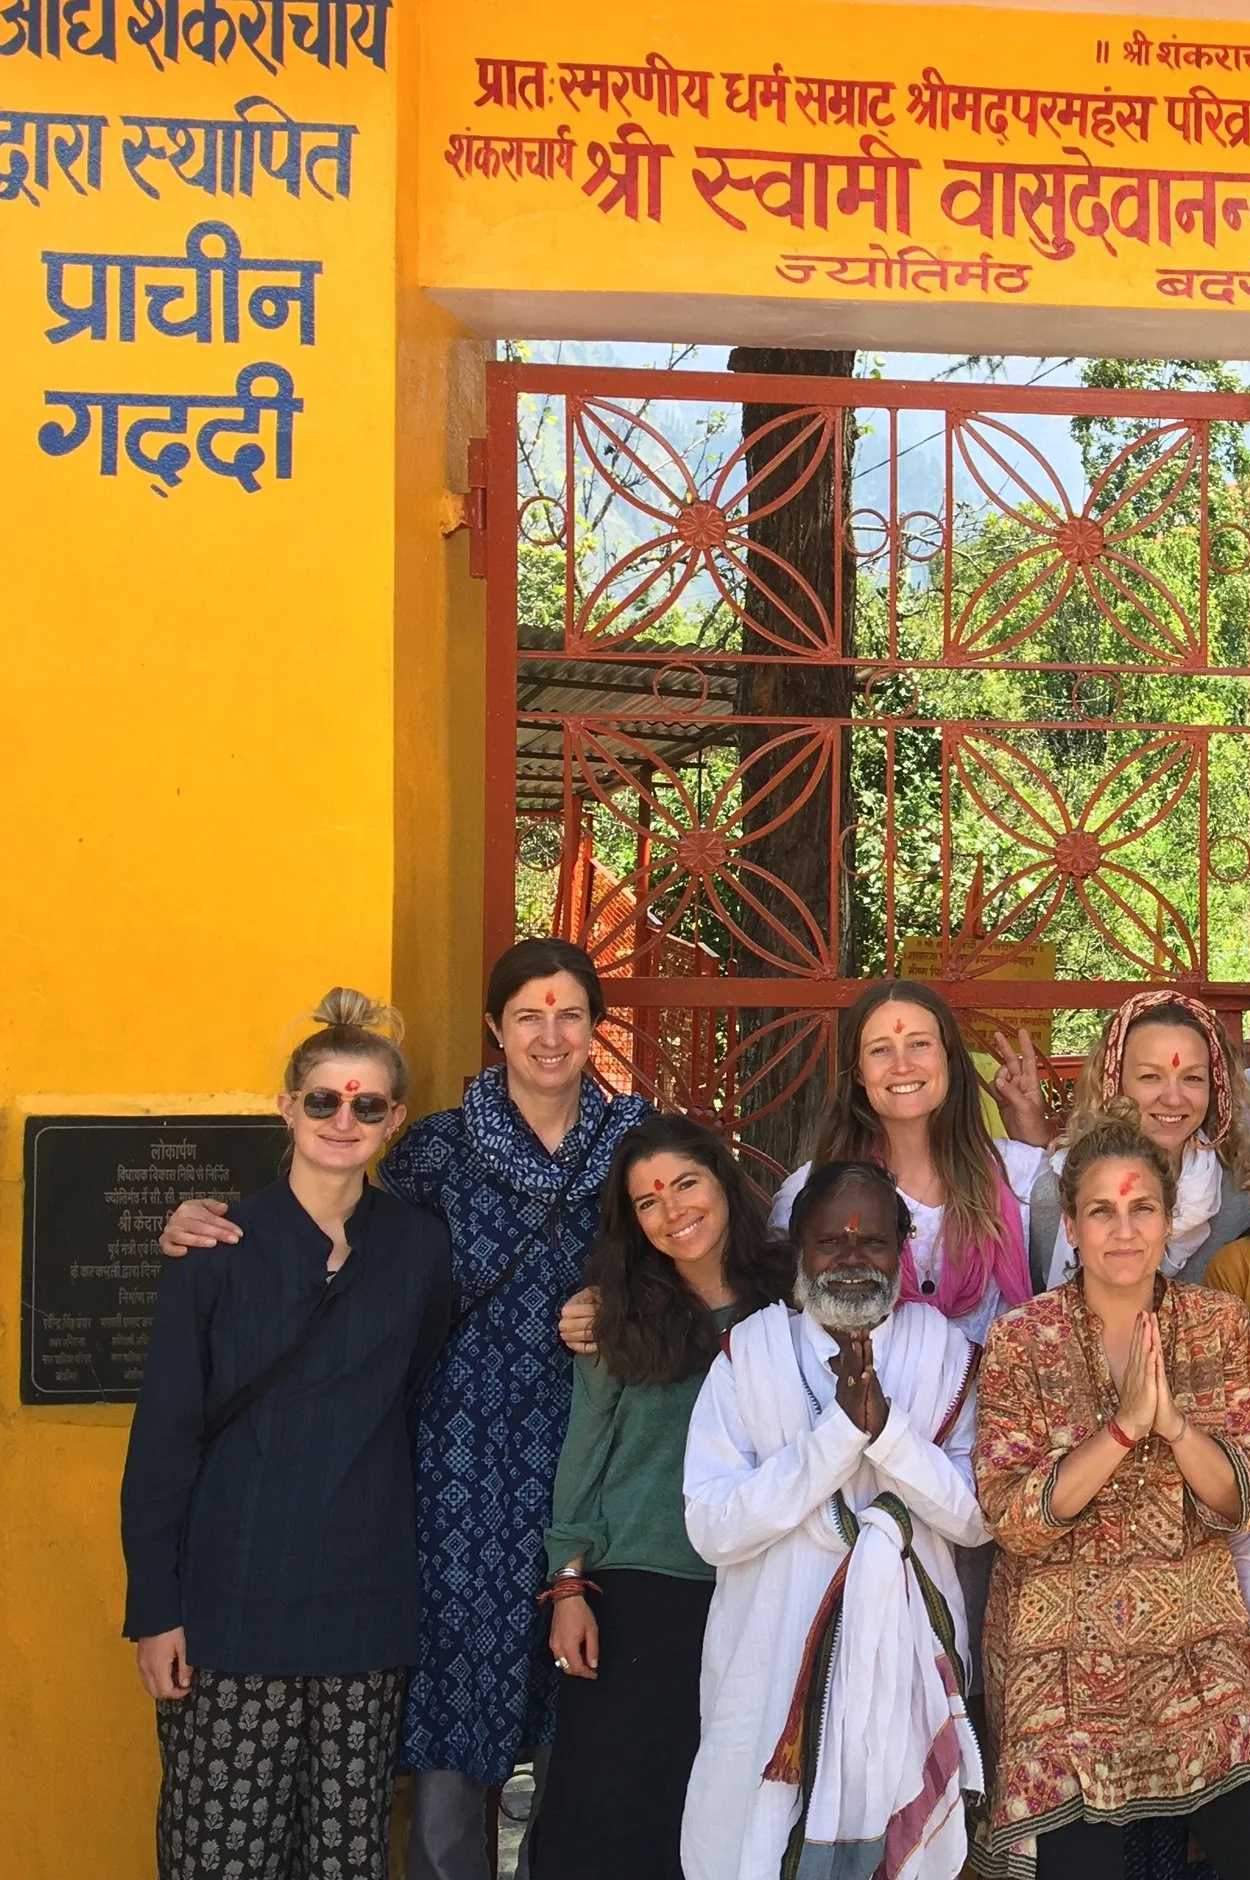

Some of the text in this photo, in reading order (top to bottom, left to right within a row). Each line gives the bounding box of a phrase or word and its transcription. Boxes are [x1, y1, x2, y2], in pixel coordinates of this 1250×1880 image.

[1123, 30, 1154, 66] श्री
[720, 63, 792, 125] धर्म
[0, 95, 360, 207] द्वारा स्थापित
[444, 124, 577, 182] शंकराचार्य
[580, 122, 676, 224] श्री
[691, 130, 922, 238] स्वामी
[41, 220, 324, 346] प्राचीन
[775, 243, 1033, 294] ज्योतिर्मठ
[150, 1138, 197, 1160] लोकार्पण
[118, 1209, 131, 1232] श्री
[133, 1210, 163, 1232] केदार
